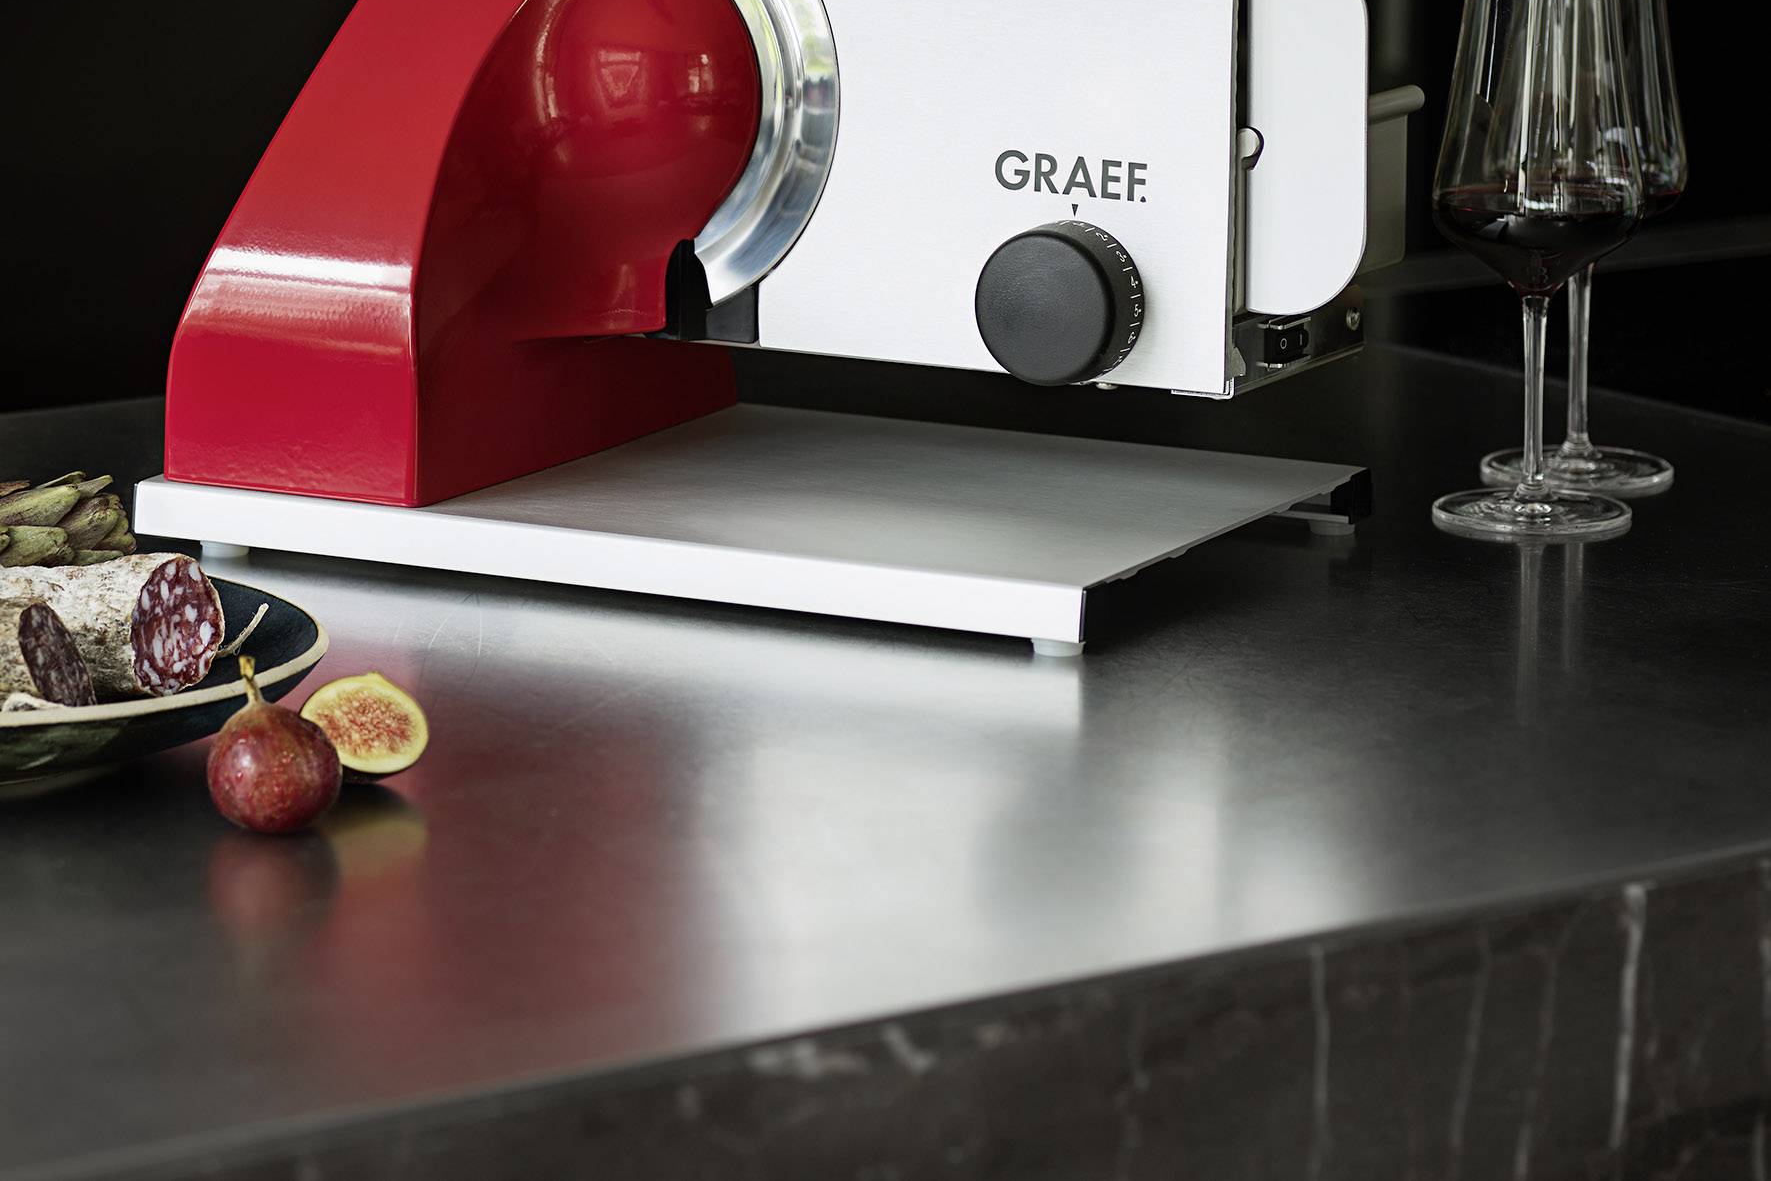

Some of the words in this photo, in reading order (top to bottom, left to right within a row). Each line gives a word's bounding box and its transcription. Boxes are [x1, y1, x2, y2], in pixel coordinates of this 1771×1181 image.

[1095, 232, 1108, 242] 2
[1115, 250, 1127, 263] 3
[1130, 275, 1138, 289] 4
[1134, 303, 1142, 317] 5
